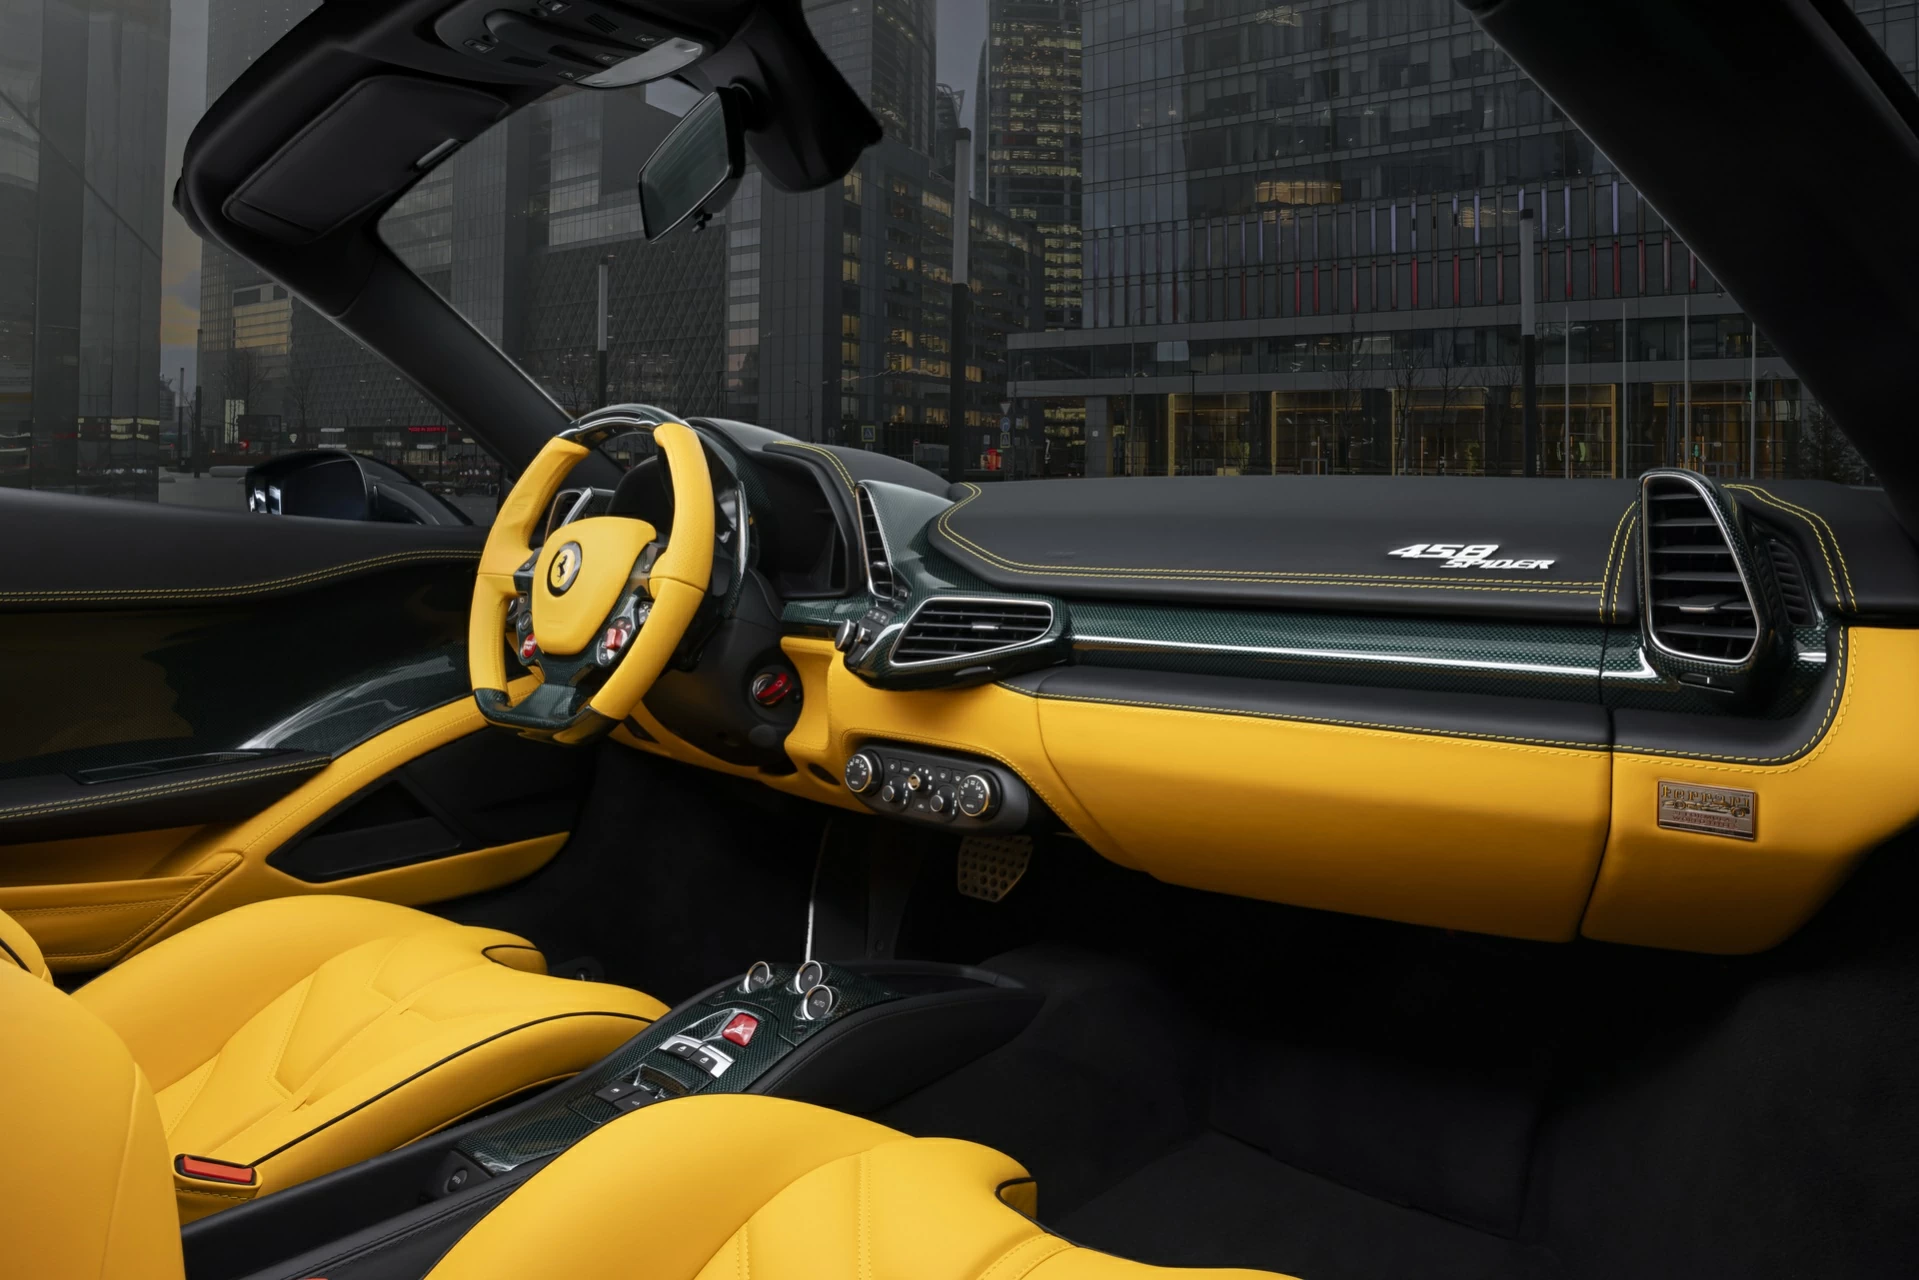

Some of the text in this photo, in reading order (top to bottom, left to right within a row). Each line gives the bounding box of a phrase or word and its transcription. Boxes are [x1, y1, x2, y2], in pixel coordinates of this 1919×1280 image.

[1387, 543, 1500, 559] 458
[1439, 558, 1556, 570] SPIDER
[813, 1000, 826, 1008] AUTO
